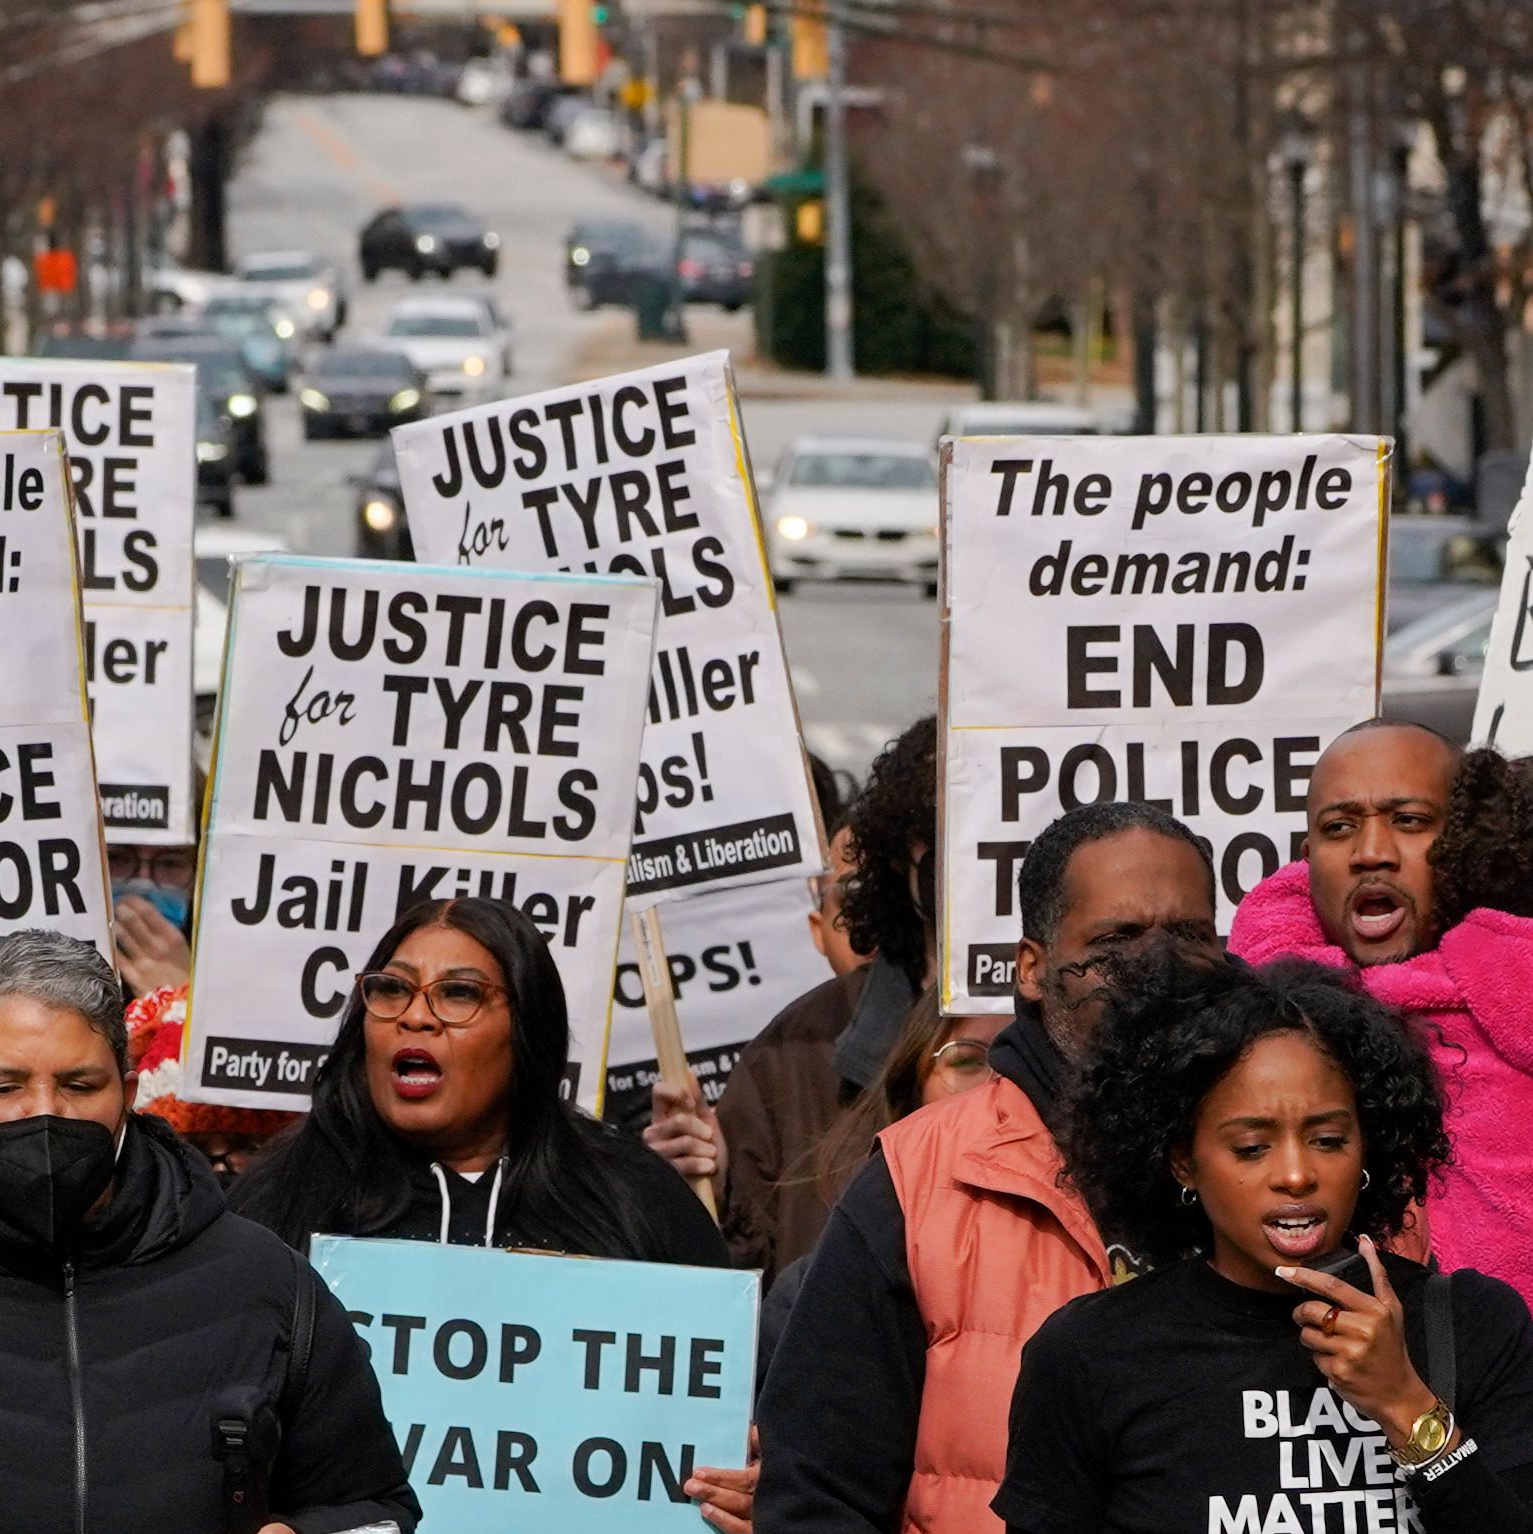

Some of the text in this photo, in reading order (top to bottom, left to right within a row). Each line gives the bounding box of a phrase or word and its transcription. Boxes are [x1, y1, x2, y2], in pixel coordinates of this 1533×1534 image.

[432, 376, 697, 499] JUSTICE
[458, 459, 701, 567] for TYRE
[990, 454, 1353, 531] The people
[1028, 535, 1312, 598] demand:
[277, 584, 611, 677] JUSTICE
[1066, 622, 1265, 711] END
[278, 665, 584, 758] for TYRE
[252, 749, 600, 842] NICHOLS
[1000, 736, 1321, 823] POLICE
[676, 844, 694, 873] &
[692, 826, 795, 872] Liberation
[230, 853, 369, 933] Jail
[209, 1046, 271, 1084] Party
[276, 1051, 312, 1083] for
[572, 1328, 726, 1401] THE
[572, 1436, 697, 1505] ON
